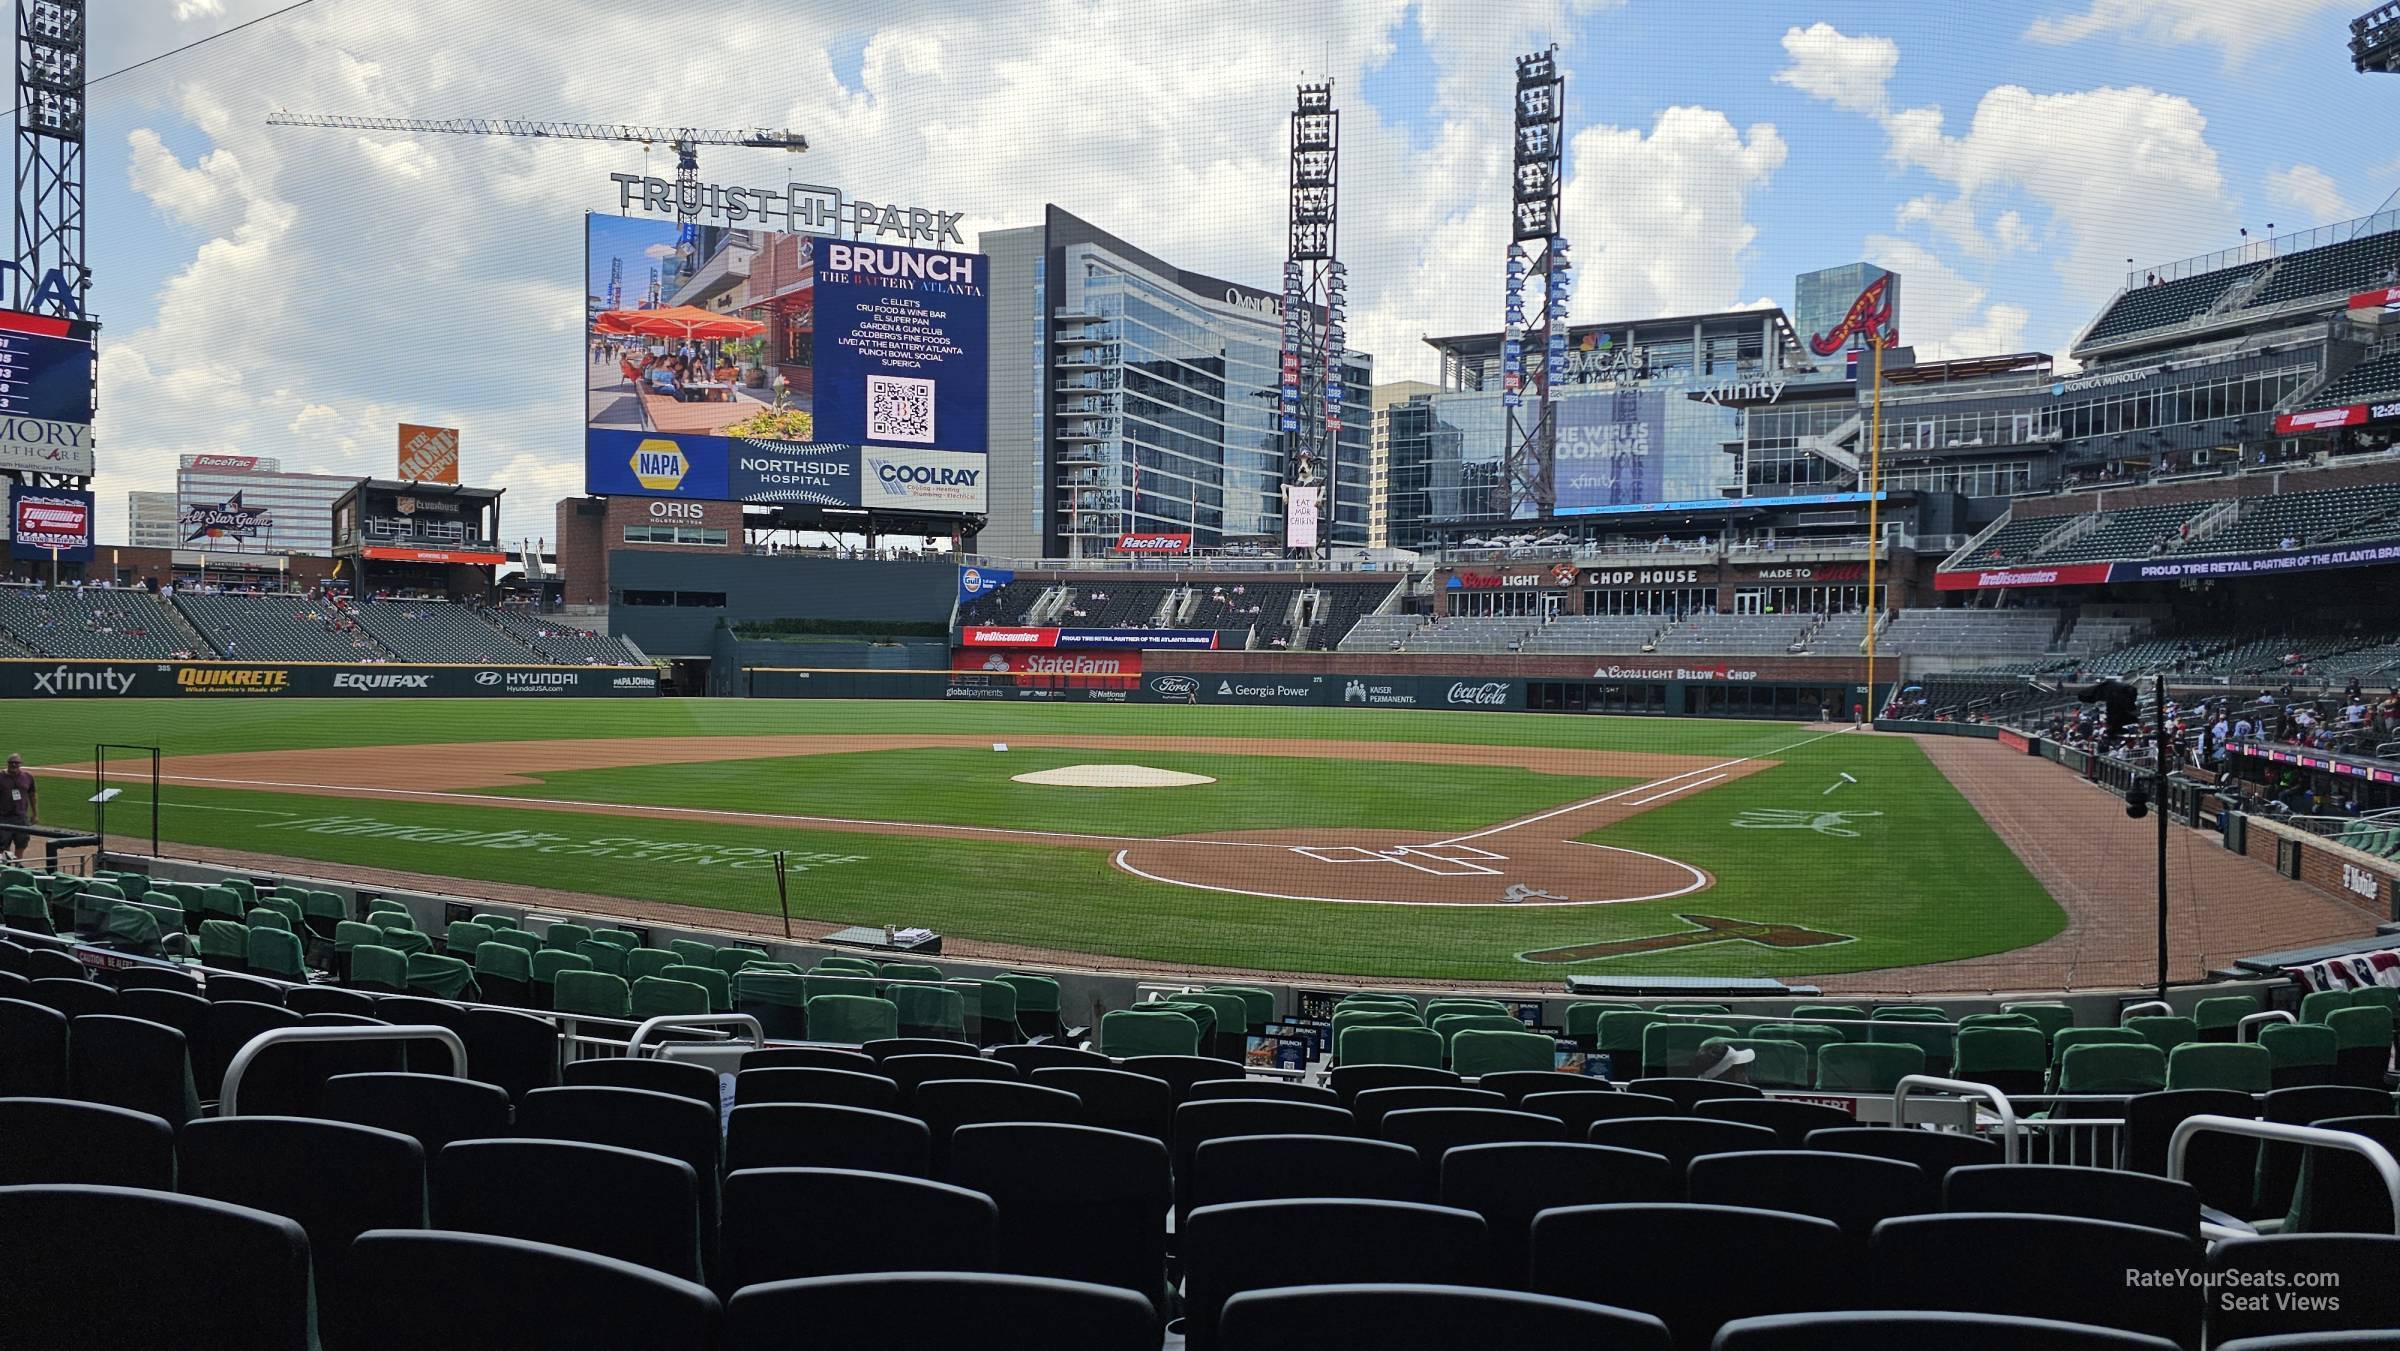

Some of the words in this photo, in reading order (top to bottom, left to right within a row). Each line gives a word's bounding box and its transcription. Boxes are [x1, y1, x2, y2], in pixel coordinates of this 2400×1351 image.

[611, 173, 777, 222] TRUIST
[854, 201, 965, 245] PARK
[829, 244, 972, 283] BRUNCH
[820, 271, 849, 284] THE
[854, 276, 916, 290] BATTERY
[1225, 288, 1260, 311] OMNI
[856, 304, 874, 312] CRU
[875, 306, 899, 314] FOOD
[907, 309, 928, 317] WINE
[874, 314, 883, 322] EL
[885, 316, 911, 324] SUPER
[860, 322, 894, 331] GARDEN
[921, 328, 942, 336] CLUB
[852, 330, 902, 340] GOLDBERG'S
[904, 335, 921, 343] FINE
[923, 336, 950, 345] FOODS
[859, 348, 887, 357] PUNCH
[889, 350, 913, 359] BOWL
[915, 353, 943, 361] SOCIAL
[872, 340, 887, 348] THE
[889, 341, 924, 351] BATTERY
[926, 345, 963, 355] ATLANTA
[882, 359, 921, 368] SUPERICA
[2065, 379, 2101, 392] KONICA
[2103, 371, 2146, 386] MINOLTA
[1701, 379, 1786, 406] xfinity
[405, 431, 430, 451] THE
[1555, 426, 1579, 443] HE
[199, 456, 252, 468] RaceTrac
[400, 429, 458, 479] HOME
[422, 449, 458, 481] DEPOT
[640, 454, 680, 476] NAPA
[740, 458, 850, 476] NORTHSIDE
[761, 475, 830, 486] HOSPITAL
[879, 464, 980, 487] COOLRAY
[1570, 473, 1617, 489] xfinity
[416, 500, 460, 513] CLUBHOUSE
[650, 502, 704, 519] ORIS
[181, 511, 206, 523] All
[206, 511, 235, 525] Star
[234, 512, 272, 528] Game
[1121, 537, 1182, 550] RaceTrac
[2142, 566, 2181, 577] PROUD
[2183, 564, 2208, 575] TIRE
[2210, 561, 2252, 573] RETAIL
[2253, 557, 2297, 571] PARTNER
[2297, 555, 2310, 567] OF
[2311, 553, 2330, 565] THE
[2331, 549, 2377, 564] ATLANTA
[964, 576, 980, 585] Gulf
[1502, 575, 1540, 586] LIGHT
[1589, 572, 1634, 585] CHOP
[1640, 570, 1698, 584] HOUSE
[1759, 570, 1792, 579] MADE
[1795, 569, 1811, 578] TO
[33, 665, 136, 694] xfinity
[176, 668, 289, 687] QUIKRETE
[506, 673, 578, 685] HYUNDAI
[1608, 665, 1642, 679] Coors
[1642, 670, 1673, 679] LIGHT
[1677, 668, 1713, 680] BELOW
[1727, 669, 1757, 680] CHOP
[333, 673, 430, 691] EQUIFAX
[1158, 678, 1190, 692] Ford
[946, 688, 1004, 698] globalpayments
[1096, 690, 1127, 699] National
[1235, 685, 1275, 697] Georgia
[1277, 685, 1309, 697] Power
[1447, 681, 1511, 705] Coca-Cola
[80, 951, 105, 966] CAUTION
[107, 956, 115, 968] BE
